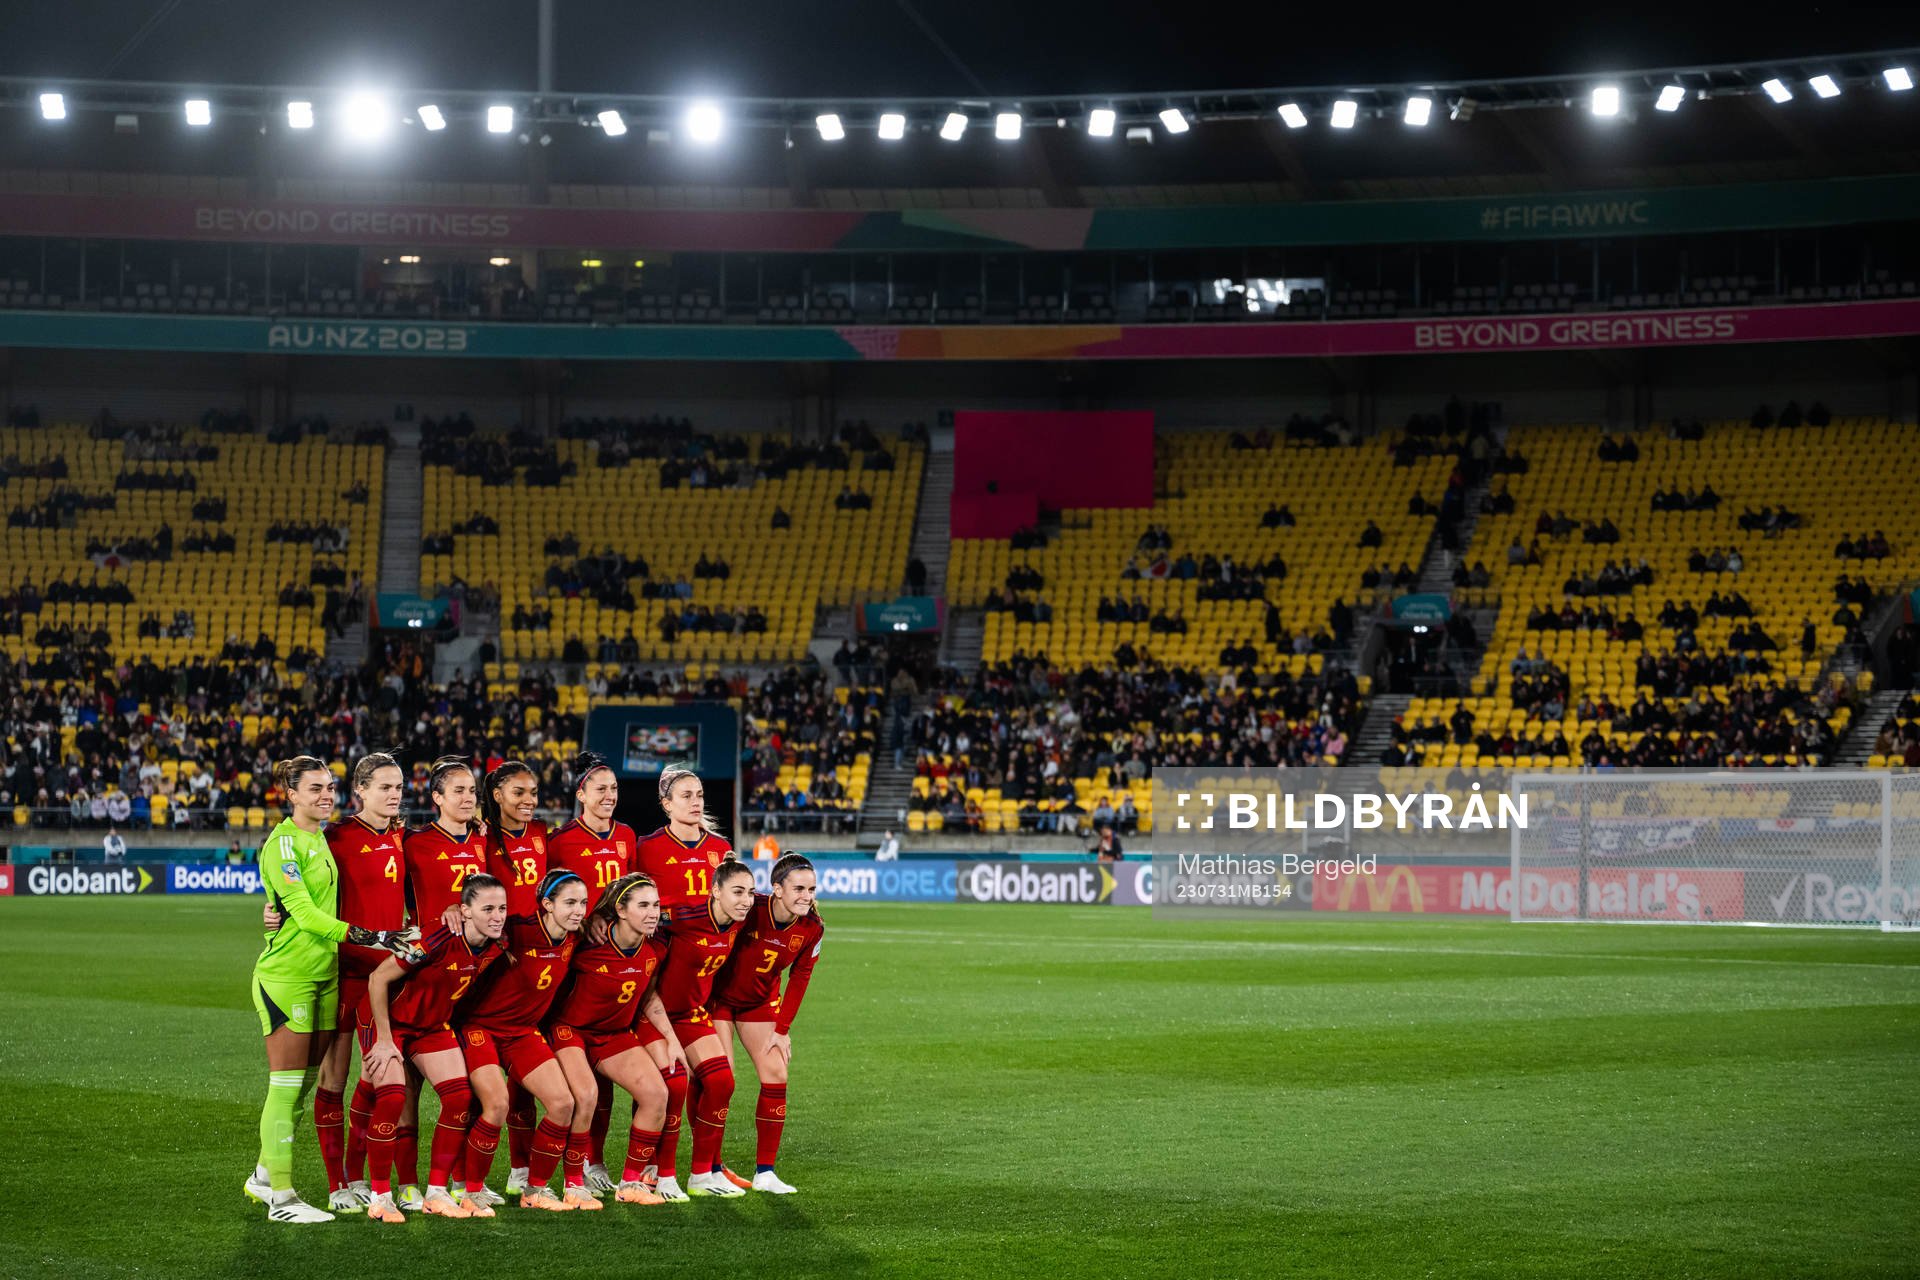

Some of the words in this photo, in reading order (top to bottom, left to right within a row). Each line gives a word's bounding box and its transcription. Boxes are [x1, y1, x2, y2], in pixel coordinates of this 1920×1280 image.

[195, 207, 318, 233] BEYOND
[329, 211, 511, 237] GREATNESS
[1480, 201, 1649, 229] #FIFAWWC
[1414, 322, 1540, 347] BEYOND
[1550, 315, 1736, 343] GREATNESS
[28, 866, 136, 895] Globant
[384, 855, 398, 883] 4
[512, 858, 538, 886] 18
[594, 860, 621, 888] 10
[684, 868, 709, 895] 11
[970, 863, 1096, 903] Globant
[755, 949, 779, 973] 3
[536, 965, 552, 990] 6
[617, 981, 637, 1003] 8
